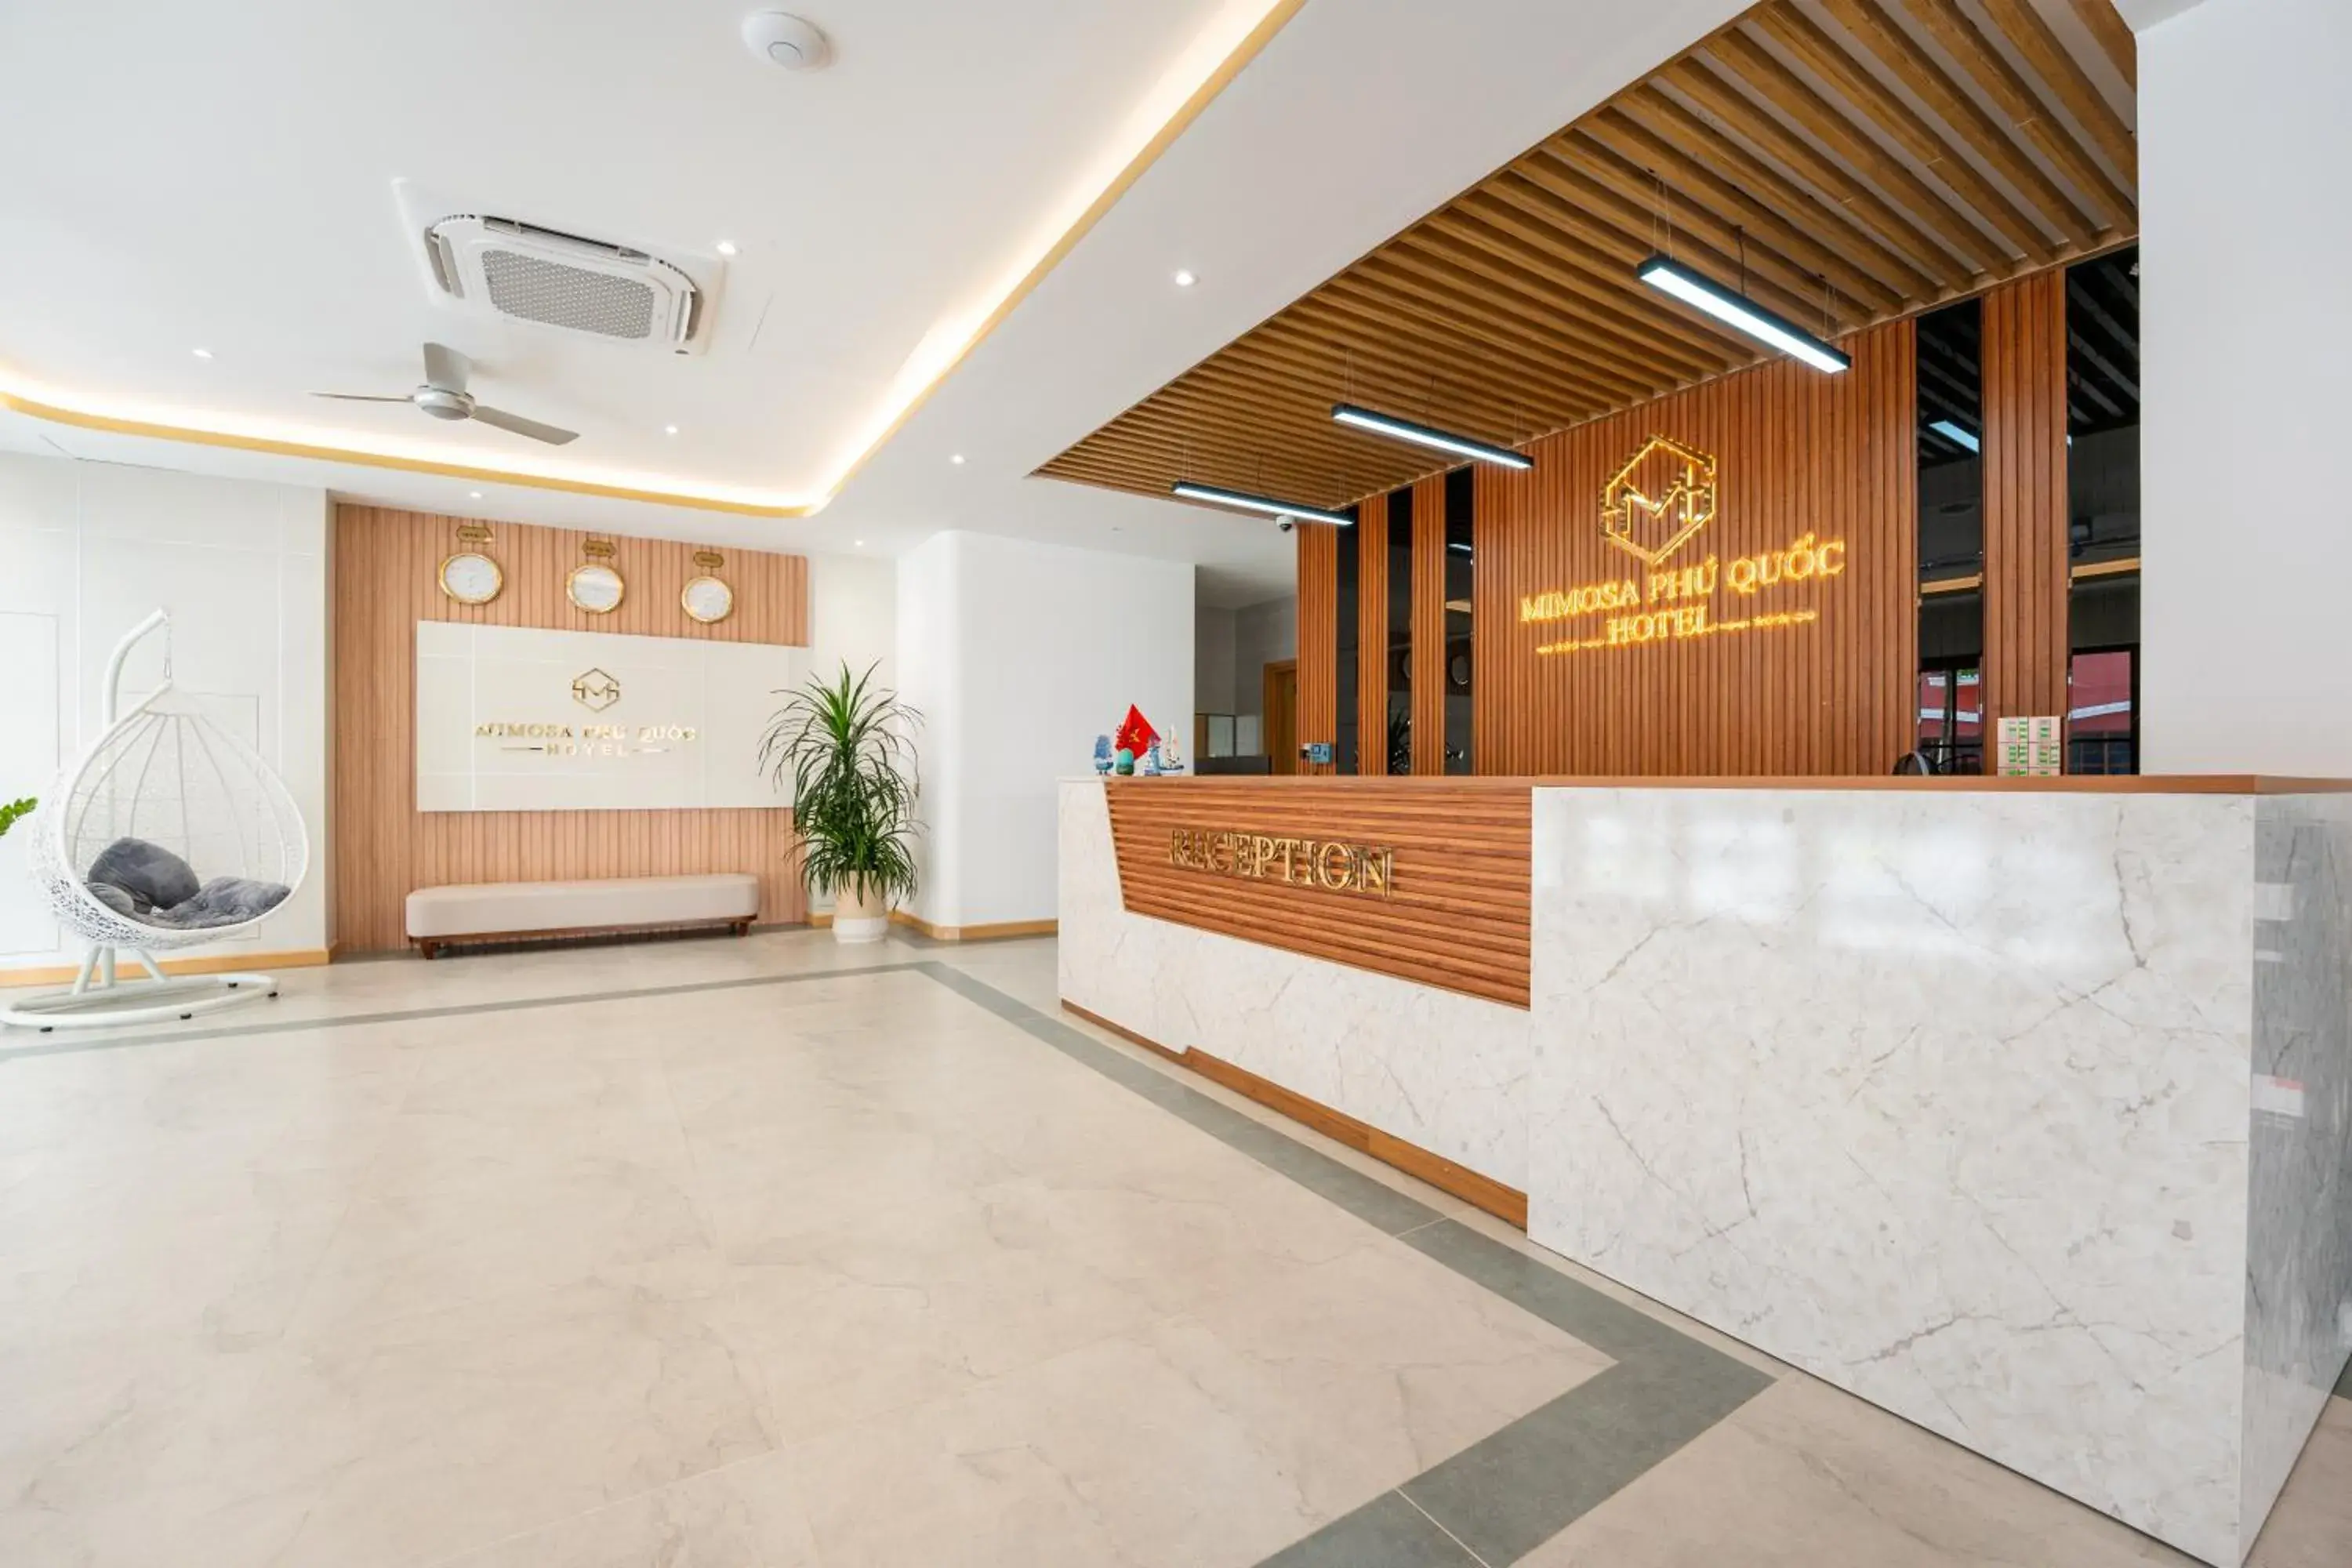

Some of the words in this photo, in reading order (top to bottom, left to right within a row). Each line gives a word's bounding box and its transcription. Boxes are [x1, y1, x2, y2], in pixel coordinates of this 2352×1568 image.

[1520, 578, 1640, 622] MIMOSA
[1727, 532, 1845, 593] QUỐC
[1606, 605, 1708, 644] HOTEL
[475, 723, 573, 738] MIMOSA
[546, 742, 628, 757] HOTEL
[1170, 828, 1393, 898] RECEPTION
